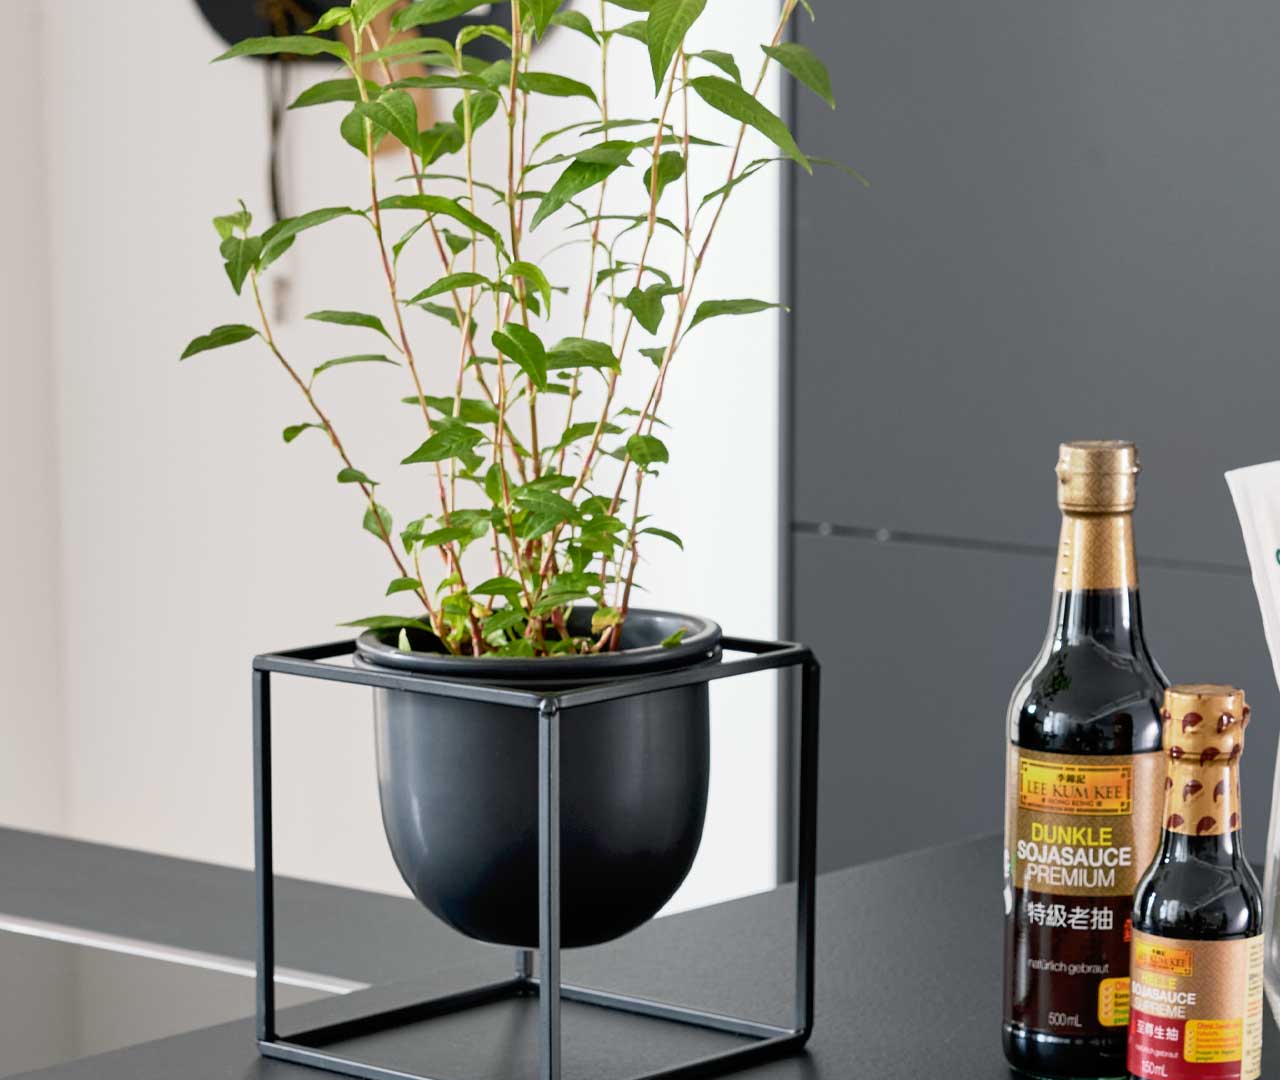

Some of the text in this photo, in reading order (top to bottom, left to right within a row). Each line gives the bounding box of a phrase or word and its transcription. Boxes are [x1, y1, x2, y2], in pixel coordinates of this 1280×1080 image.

[1027, 780, 1122, 800] LEE KUM KEE
[1031, 822, 1113, 846] DUNKLE
[1017, 840, 1132, 867] SOJASAUCE
[1027, 863, 1115, 888] PREMIUM
[1027, 901, 1114, 930] 特級老抽
[1068, 962, 1109, 975] gebraut
